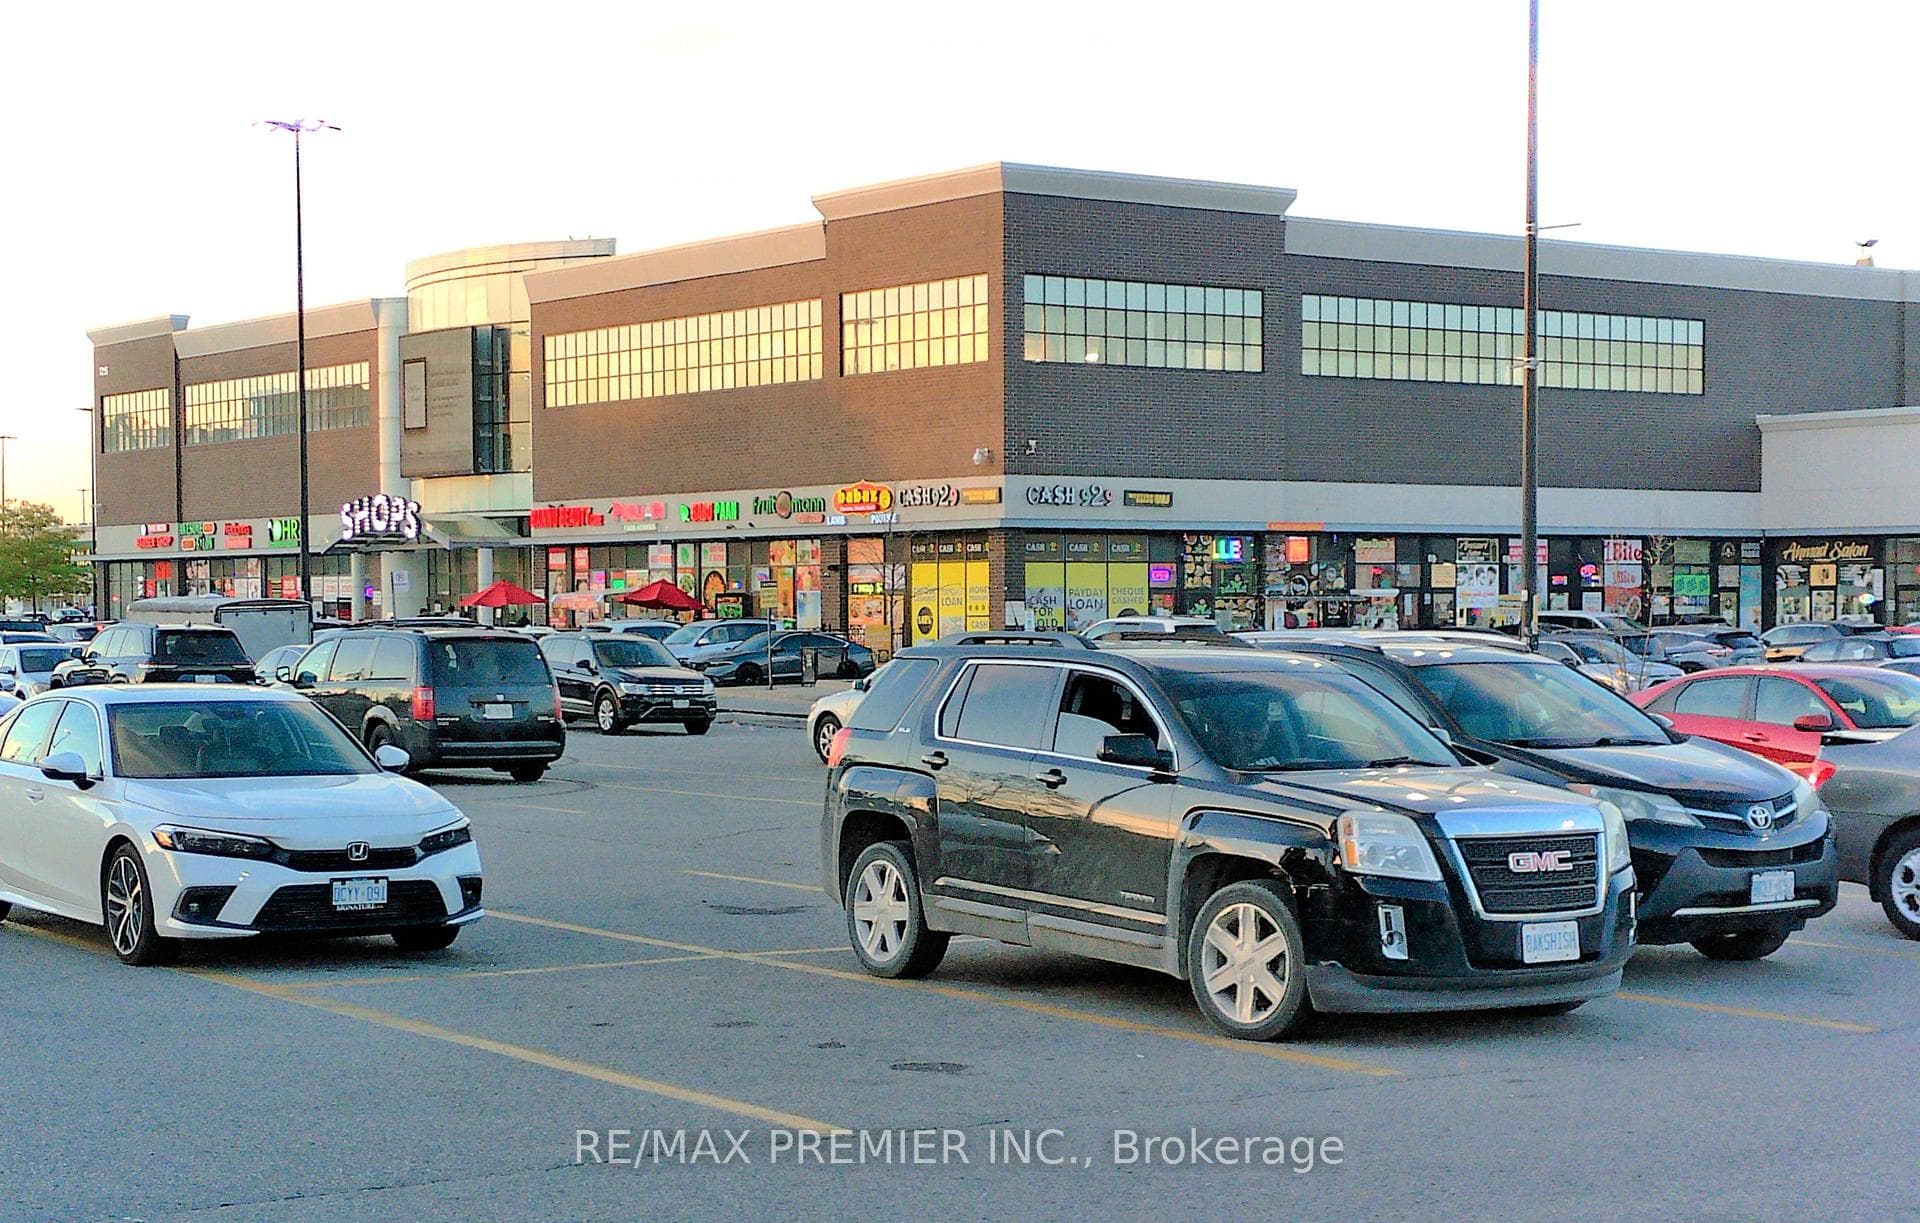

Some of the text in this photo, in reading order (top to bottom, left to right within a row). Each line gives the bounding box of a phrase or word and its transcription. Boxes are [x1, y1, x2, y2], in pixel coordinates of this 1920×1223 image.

[899, 485, 932, 507] CASH
[932, 484, 960, 507] 929
[1026, 485, 1076, 506] CASH
[1079, 484, 1114, 507] 929
[340, 494, 421, 540] SHOPS
[1069, 587, 1104, 597] PAYDAY
[1112, 587, 1144, 595] CHEQUE
[1034, 607, 1054, 616] FOR
[1069, 598, 1103, 609] LOAN
[1035, 618, 1058, 628] OLD
[1508, 850, 1573, 872] GMC
[1525, 931, 1577, 953] BAKSHISH
